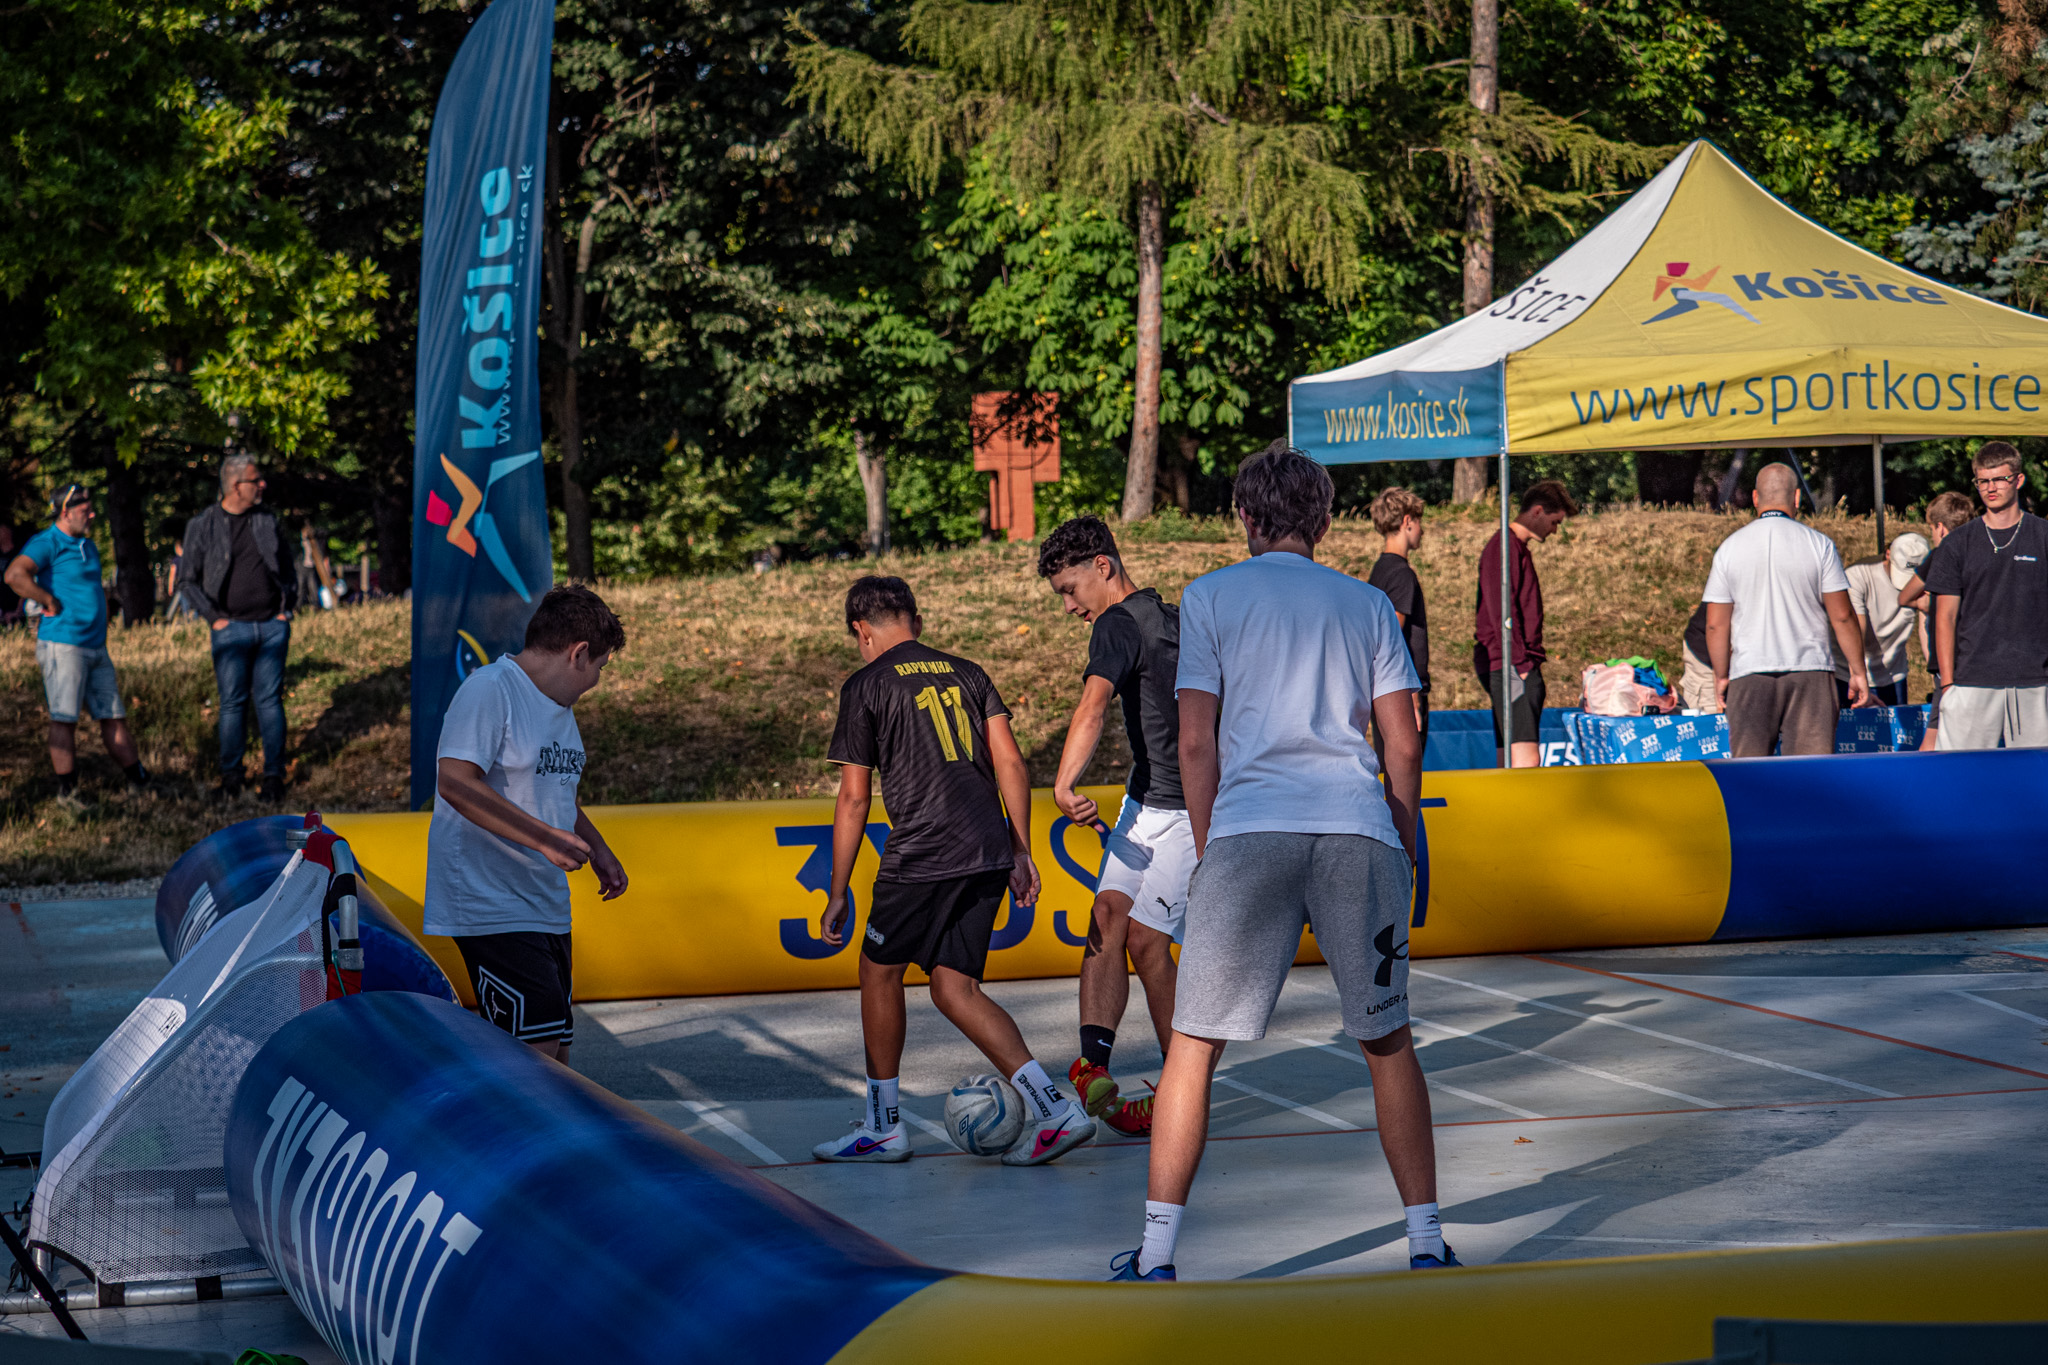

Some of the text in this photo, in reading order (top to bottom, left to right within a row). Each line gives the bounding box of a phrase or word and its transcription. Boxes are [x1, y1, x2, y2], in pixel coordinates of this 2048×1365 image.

[458, 165, 514, 449] Košice
[1732, 268, 1949, 305] Košice
[1323, 386, 1471, 444] www.kosice.sk
[1570, 359, 2042, 425] www.sportkosice
[914, 685, 974, 762] 11
[1366, 994, 1400, 1015] UNDER
